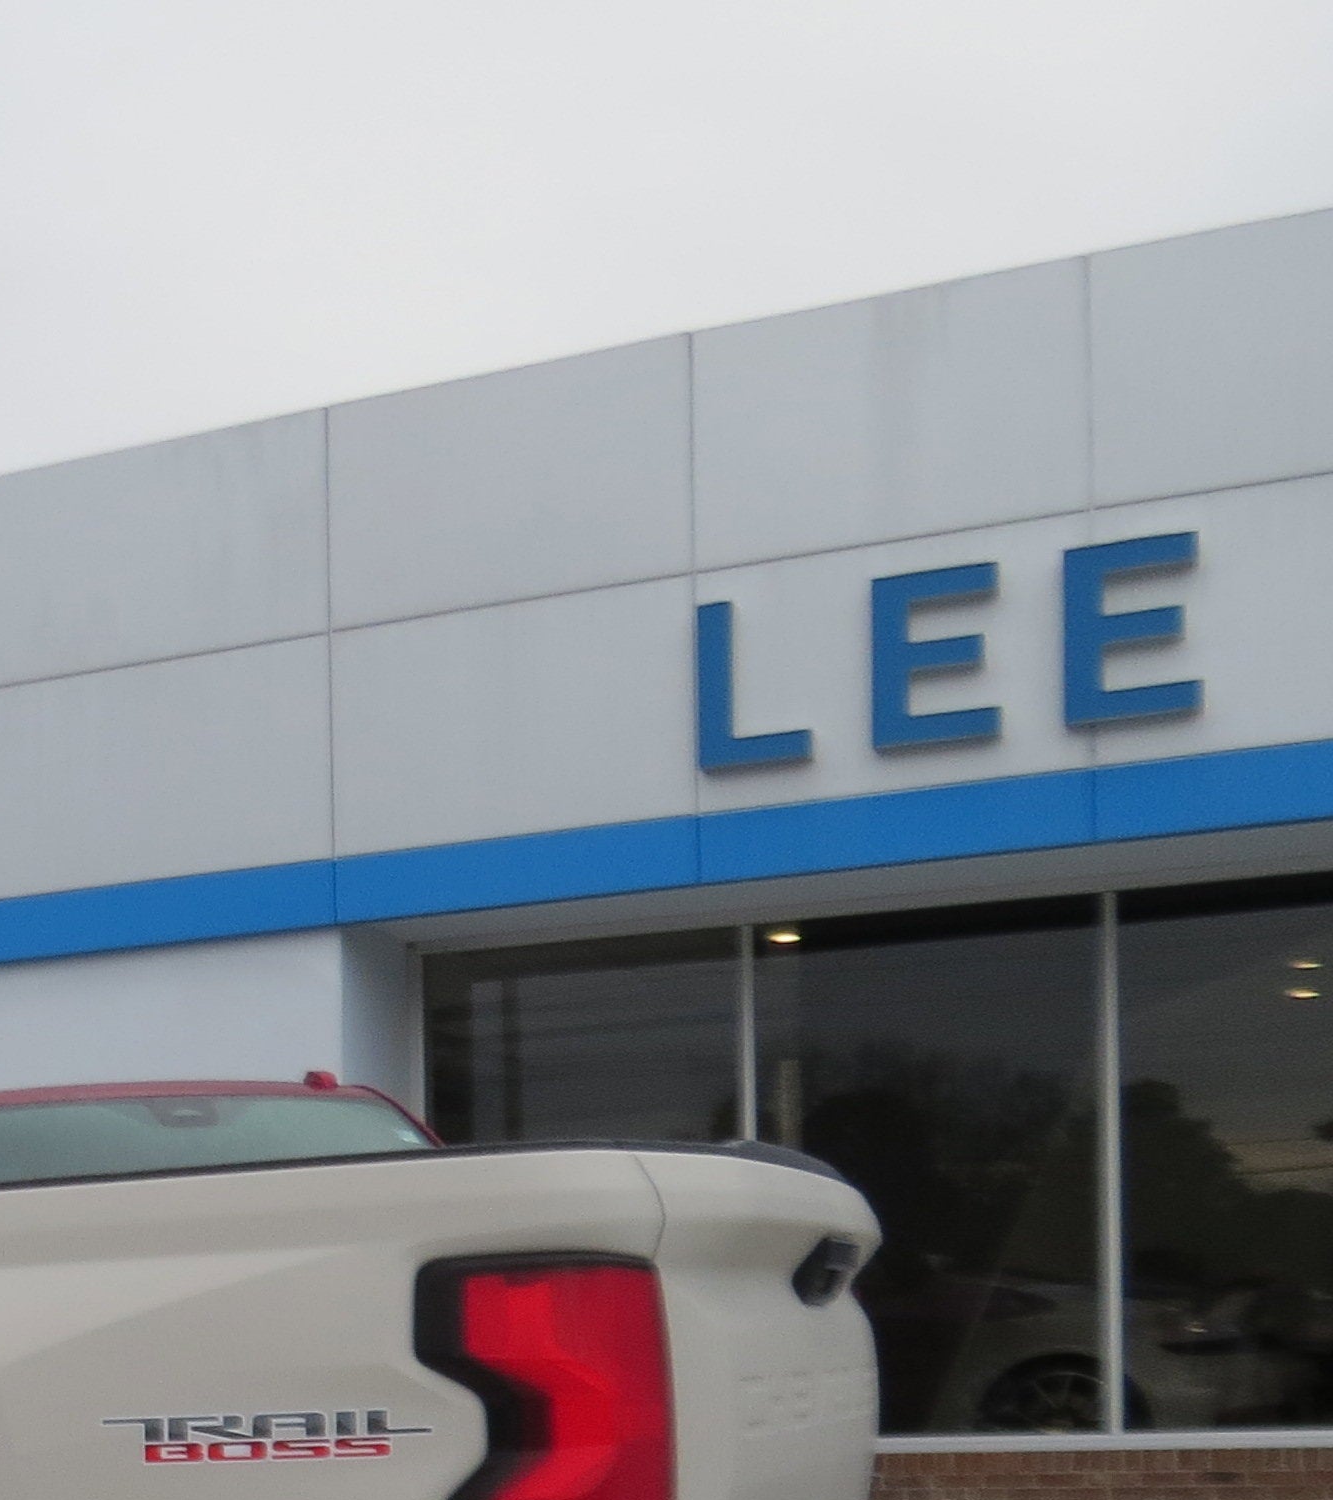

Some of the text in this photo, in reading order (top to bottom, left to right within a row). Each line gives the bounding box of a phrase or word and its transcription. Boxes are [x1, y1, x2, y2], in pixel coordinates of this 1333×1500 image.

[695, 530, 1203, 773] LEE
[102, 1410, 432, 1442] TRAIL
[144, 1437, 391, 1464] BOSS
